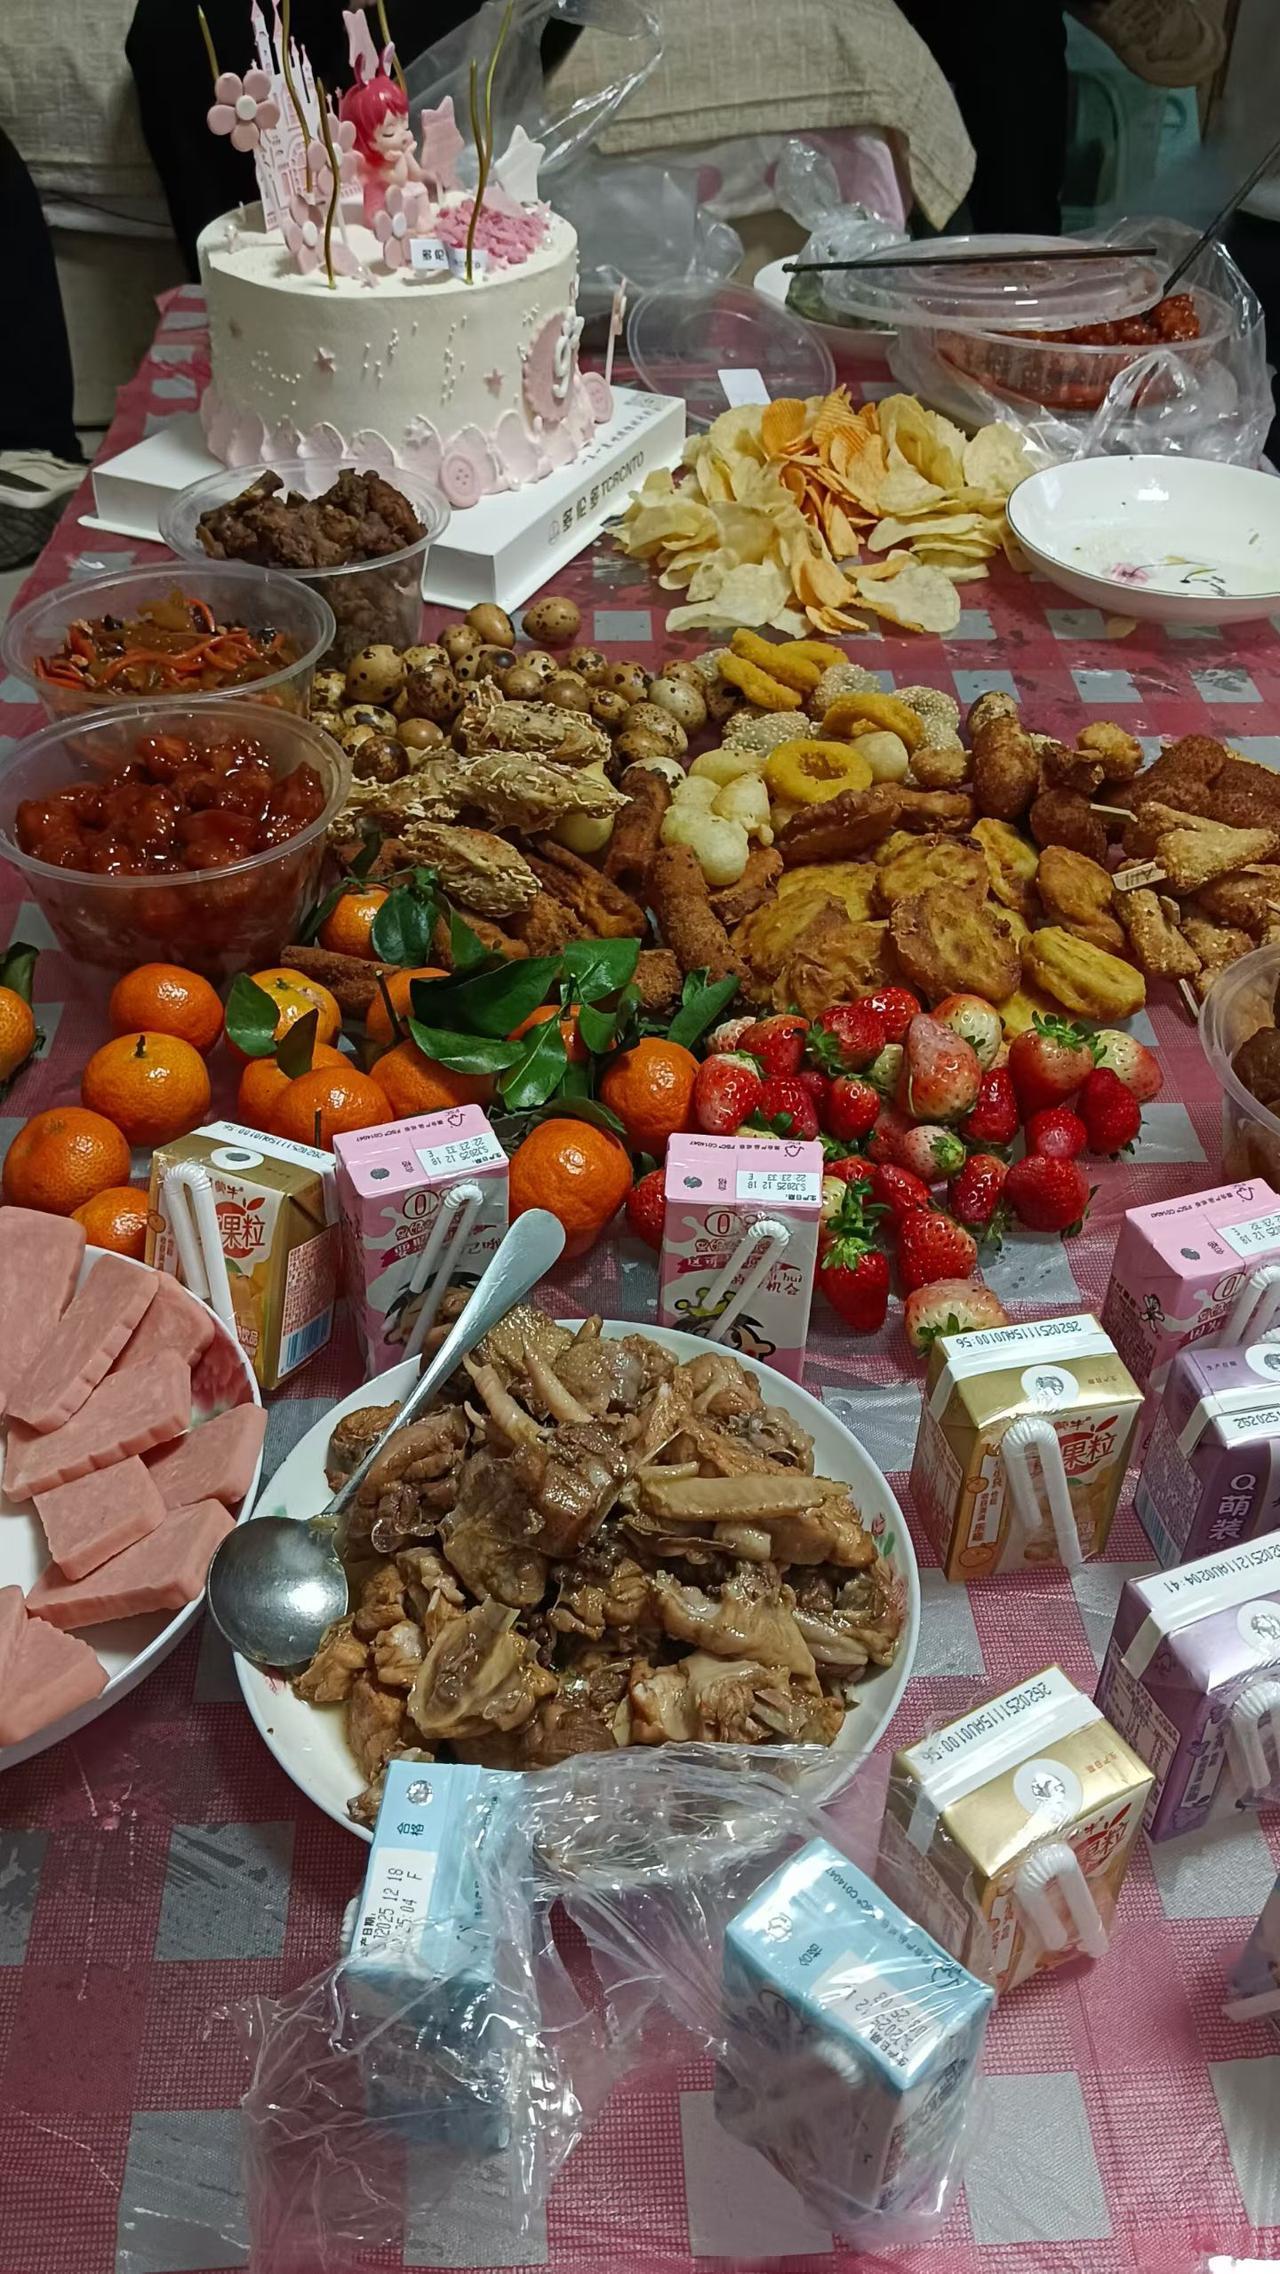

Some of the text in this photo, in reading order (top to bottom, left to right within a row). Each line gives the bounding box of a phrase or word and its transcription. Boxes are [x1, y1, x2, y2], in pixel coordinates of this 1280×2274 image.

[601, 451, 644, 497] TORONTO
[396, 1821, 425, 1836] 合格
[387, 1867, 404, 1882] 18
[407, 1871, 423, 1881] F
[825, 1867, 858, 1899] C014047
[382, 1888, 400, 1901] 12
[798, 1942, 823, 1967] 合格
